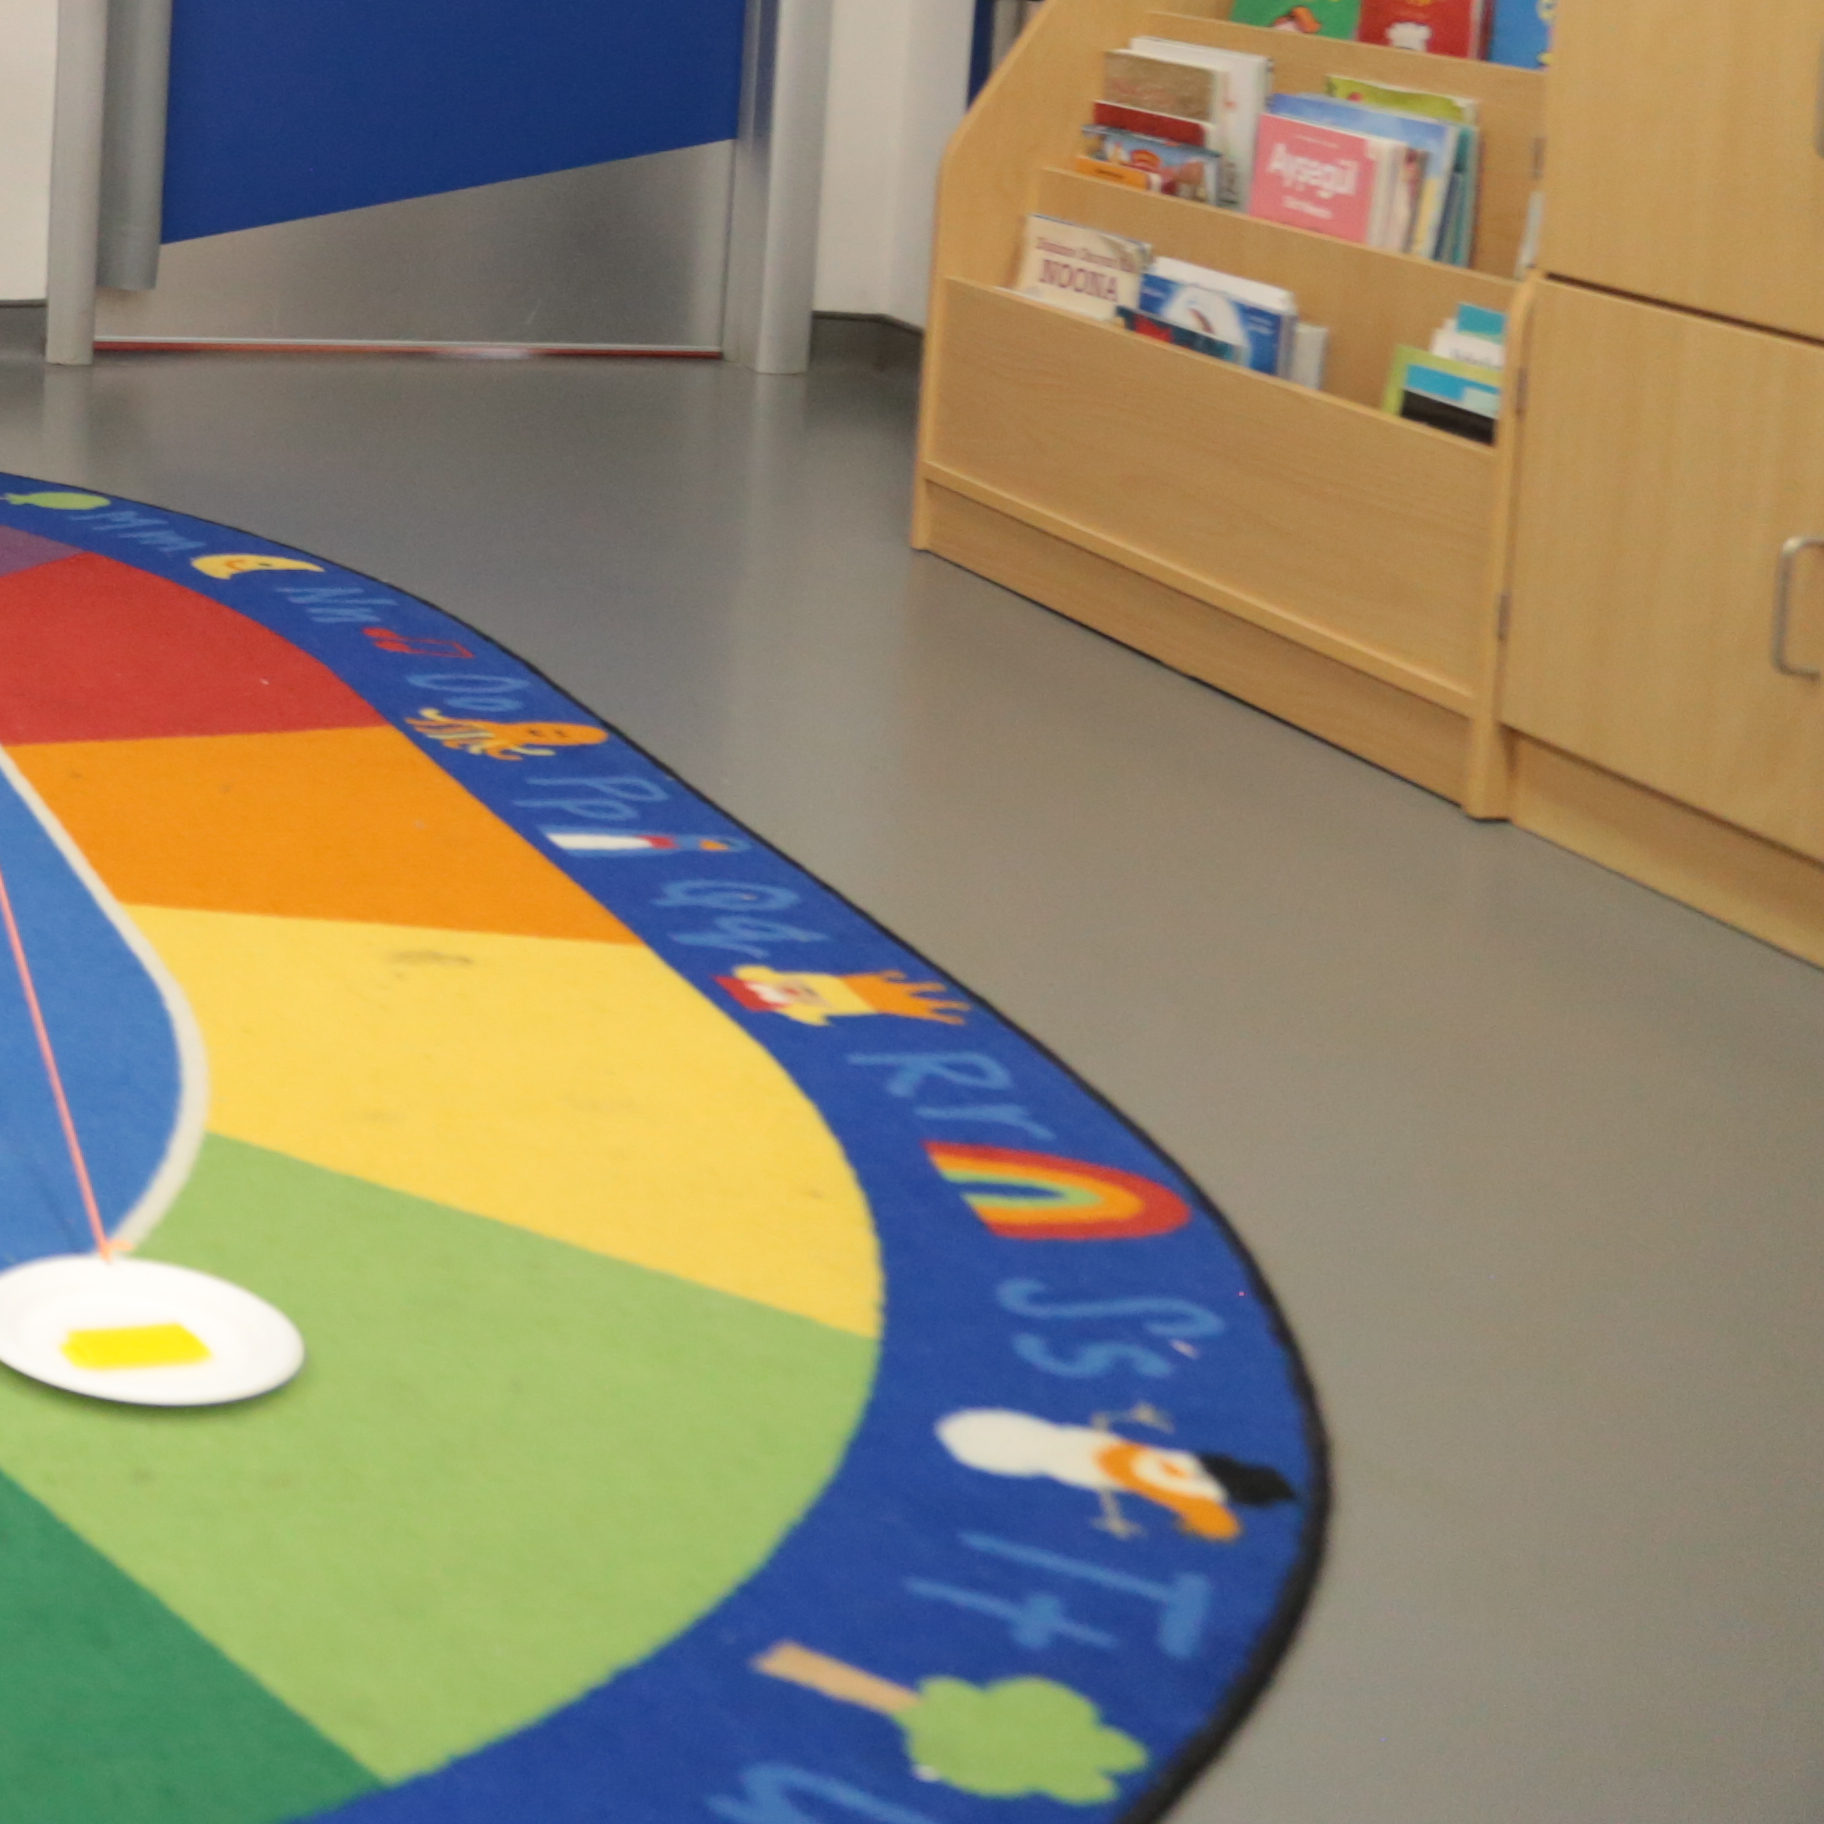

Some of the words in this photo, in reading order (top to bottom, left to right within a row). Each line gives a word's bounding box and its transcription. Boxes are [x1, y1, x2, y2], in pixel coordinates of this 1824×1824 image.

[67, 507, 207, 555] Mm
[405, 671, 532, 712] Oo
[512, 774, 672, 824] Pp
[651, 878, 830, 959] Qq
[844, 1049, 1057, 1140] Rr
[995, 1278, 1227, 1379] Ss
[904, 1530, 1213, 1660] Tt
